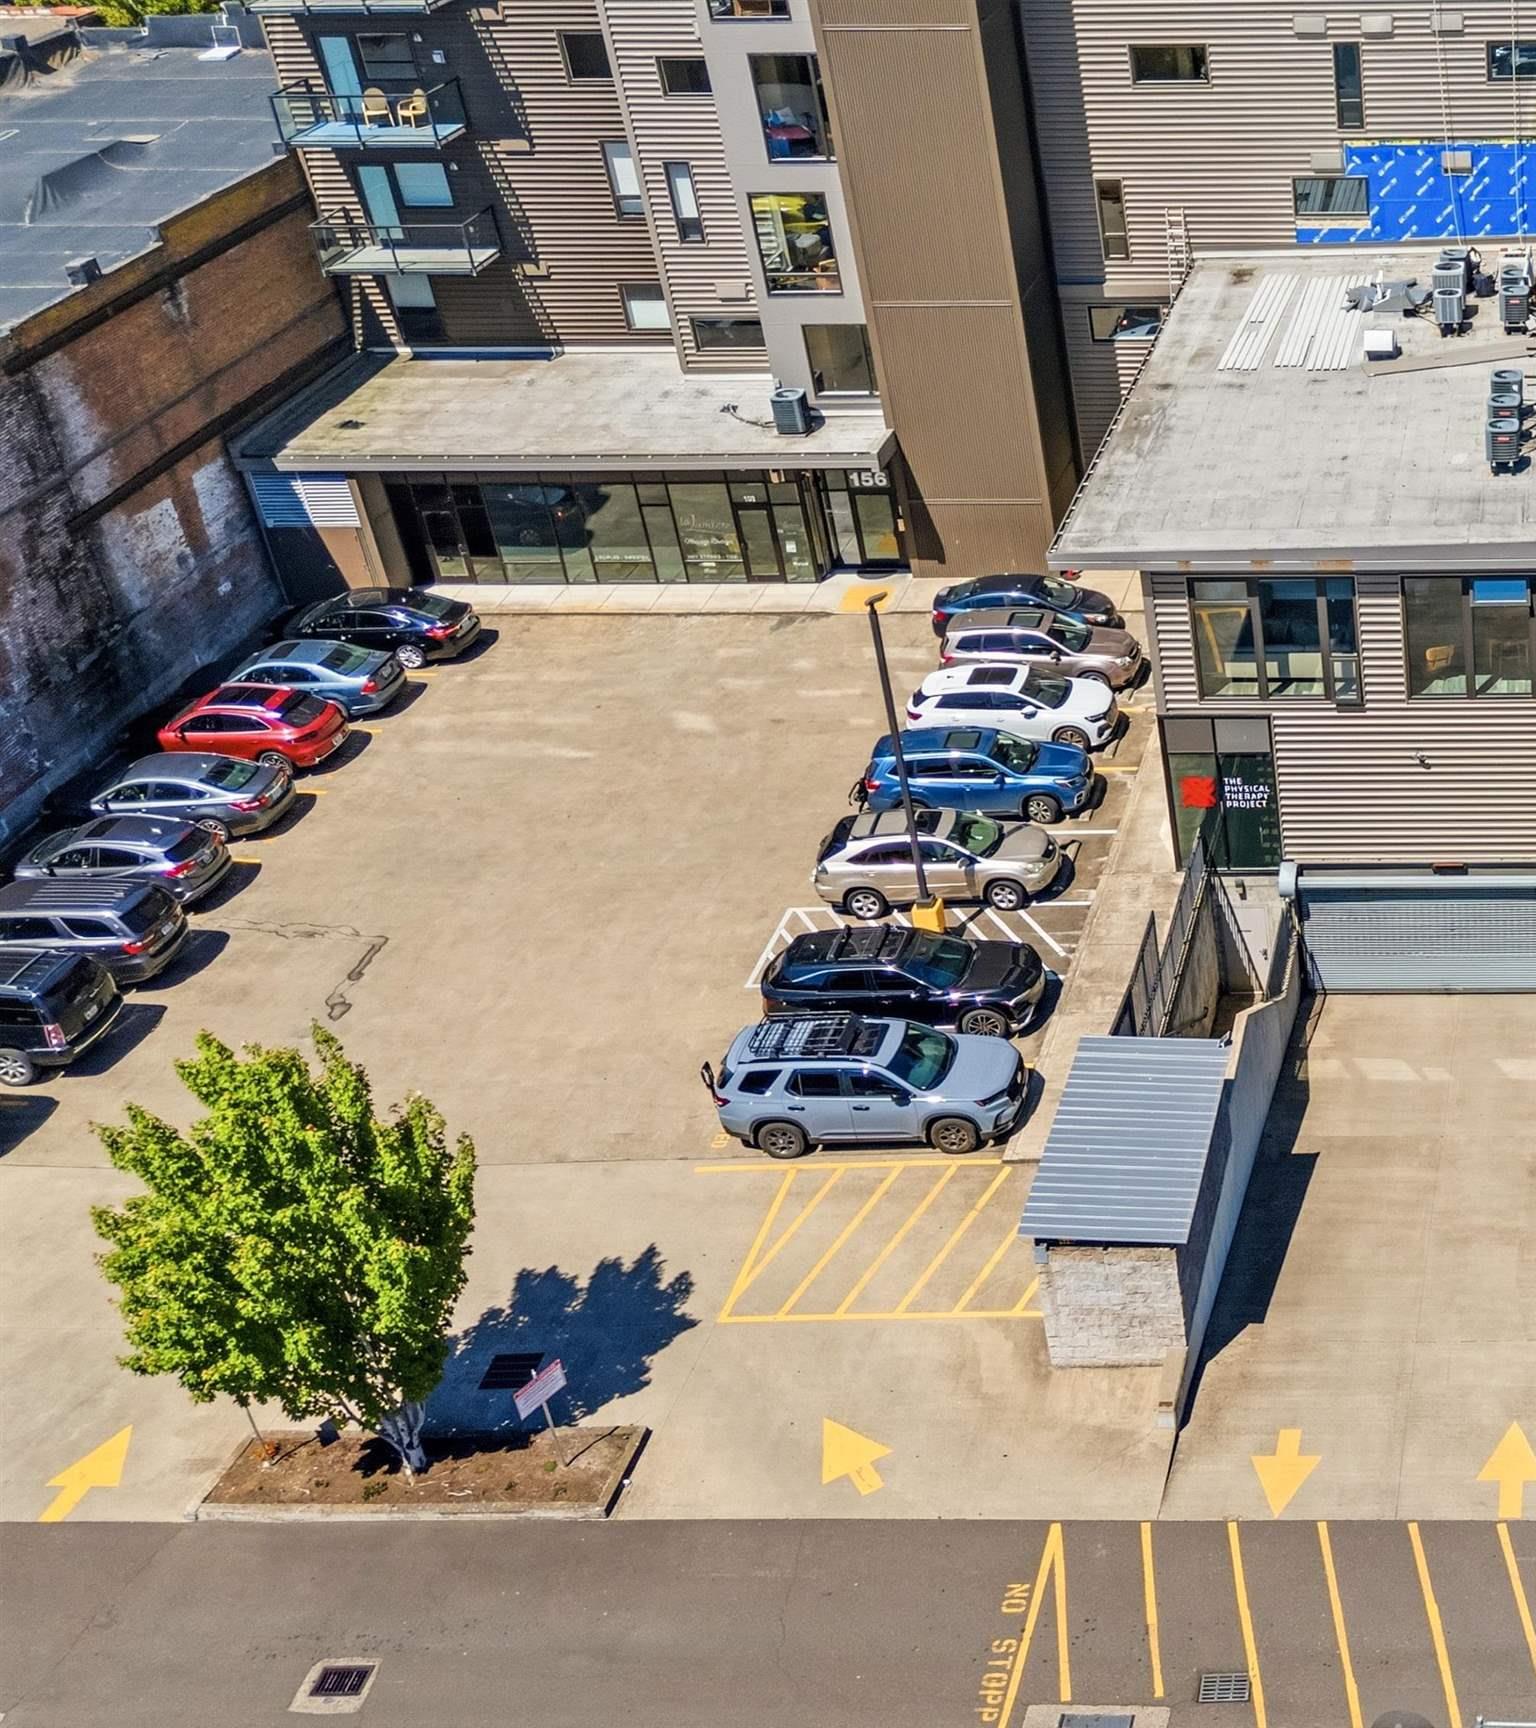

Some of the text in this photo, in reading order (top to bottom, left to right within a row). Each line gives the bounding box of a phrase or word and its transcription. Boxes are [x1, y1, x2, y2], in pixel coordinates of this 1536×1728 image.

[849, 472, 888, 487] 156
[1223, 777, 1242, 785] THE
[1224, 785, 1270, 793] PHYSICAL
[1226, 800, 1267, 808] PROJECT
[1001, 1583, 1031, 1614] NO
